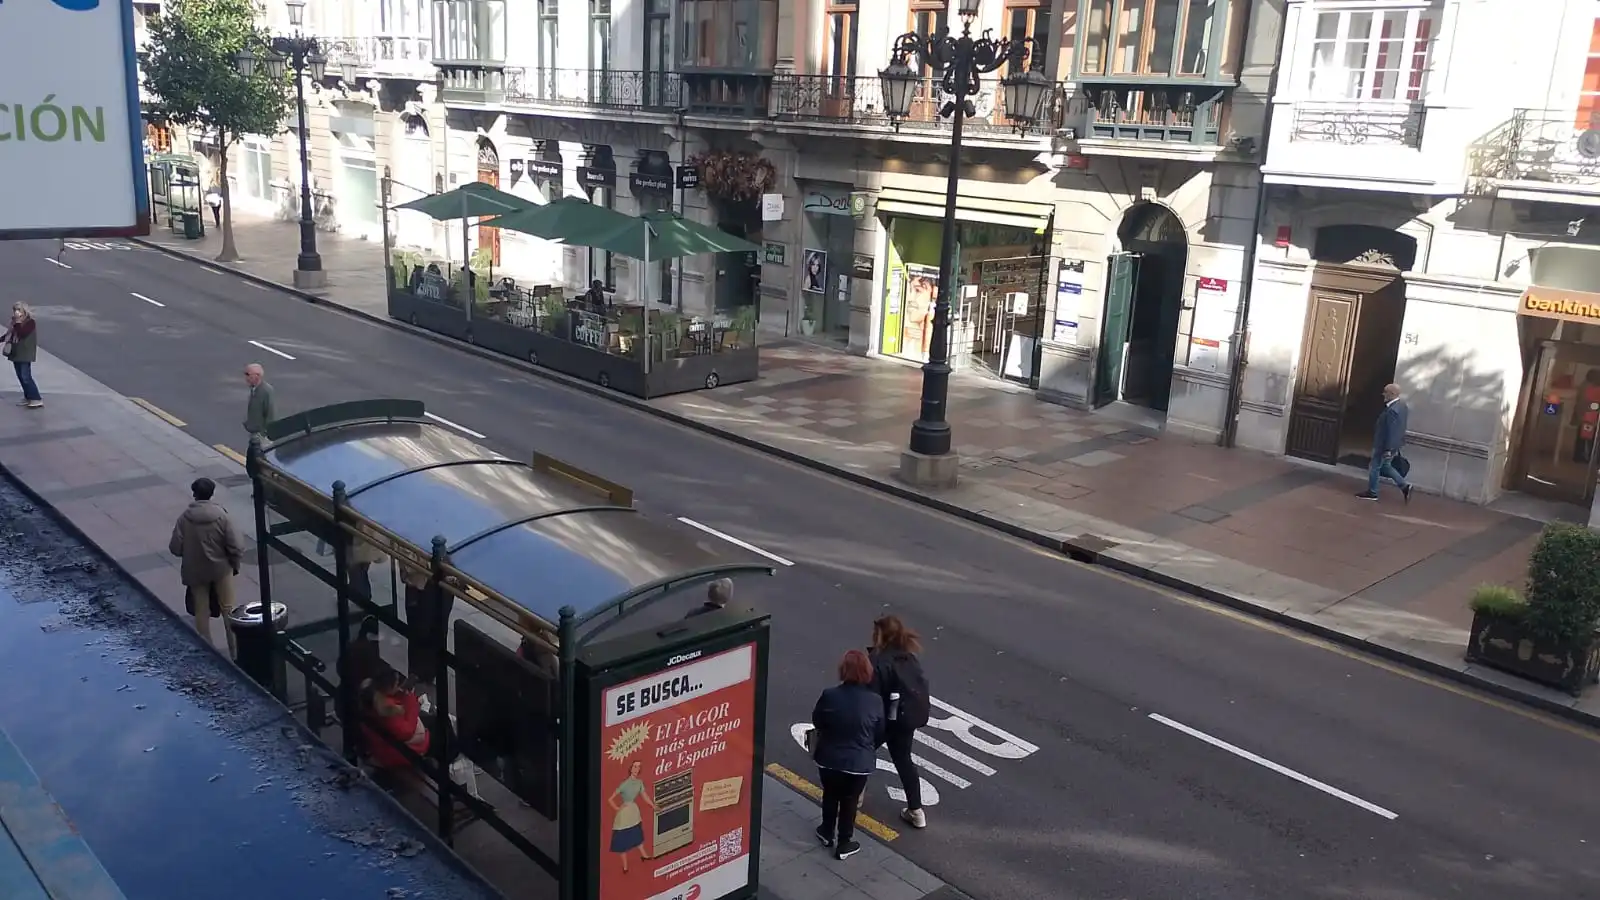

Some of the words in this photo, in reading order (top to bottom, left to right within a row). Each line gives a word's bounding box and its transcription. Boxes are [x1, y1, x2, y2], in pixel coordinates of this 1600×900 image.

[1526, 294, 1600, 318] bankint
[1404, 332, 1419, 347] 54
[667, 650, 702, 666] JCDecaux
[616, 692, 635, 716] SE
[640, 675, 703, 708] BUSCA...
[655, 723, 672, 742] El
[675, 702, 729, 735] FAGOR
[655, 737, 685, 758] más
[688, 718, 741, 746] antiguo
[655, 758, 673, 775] de
[677, 740, 726, 768] España
